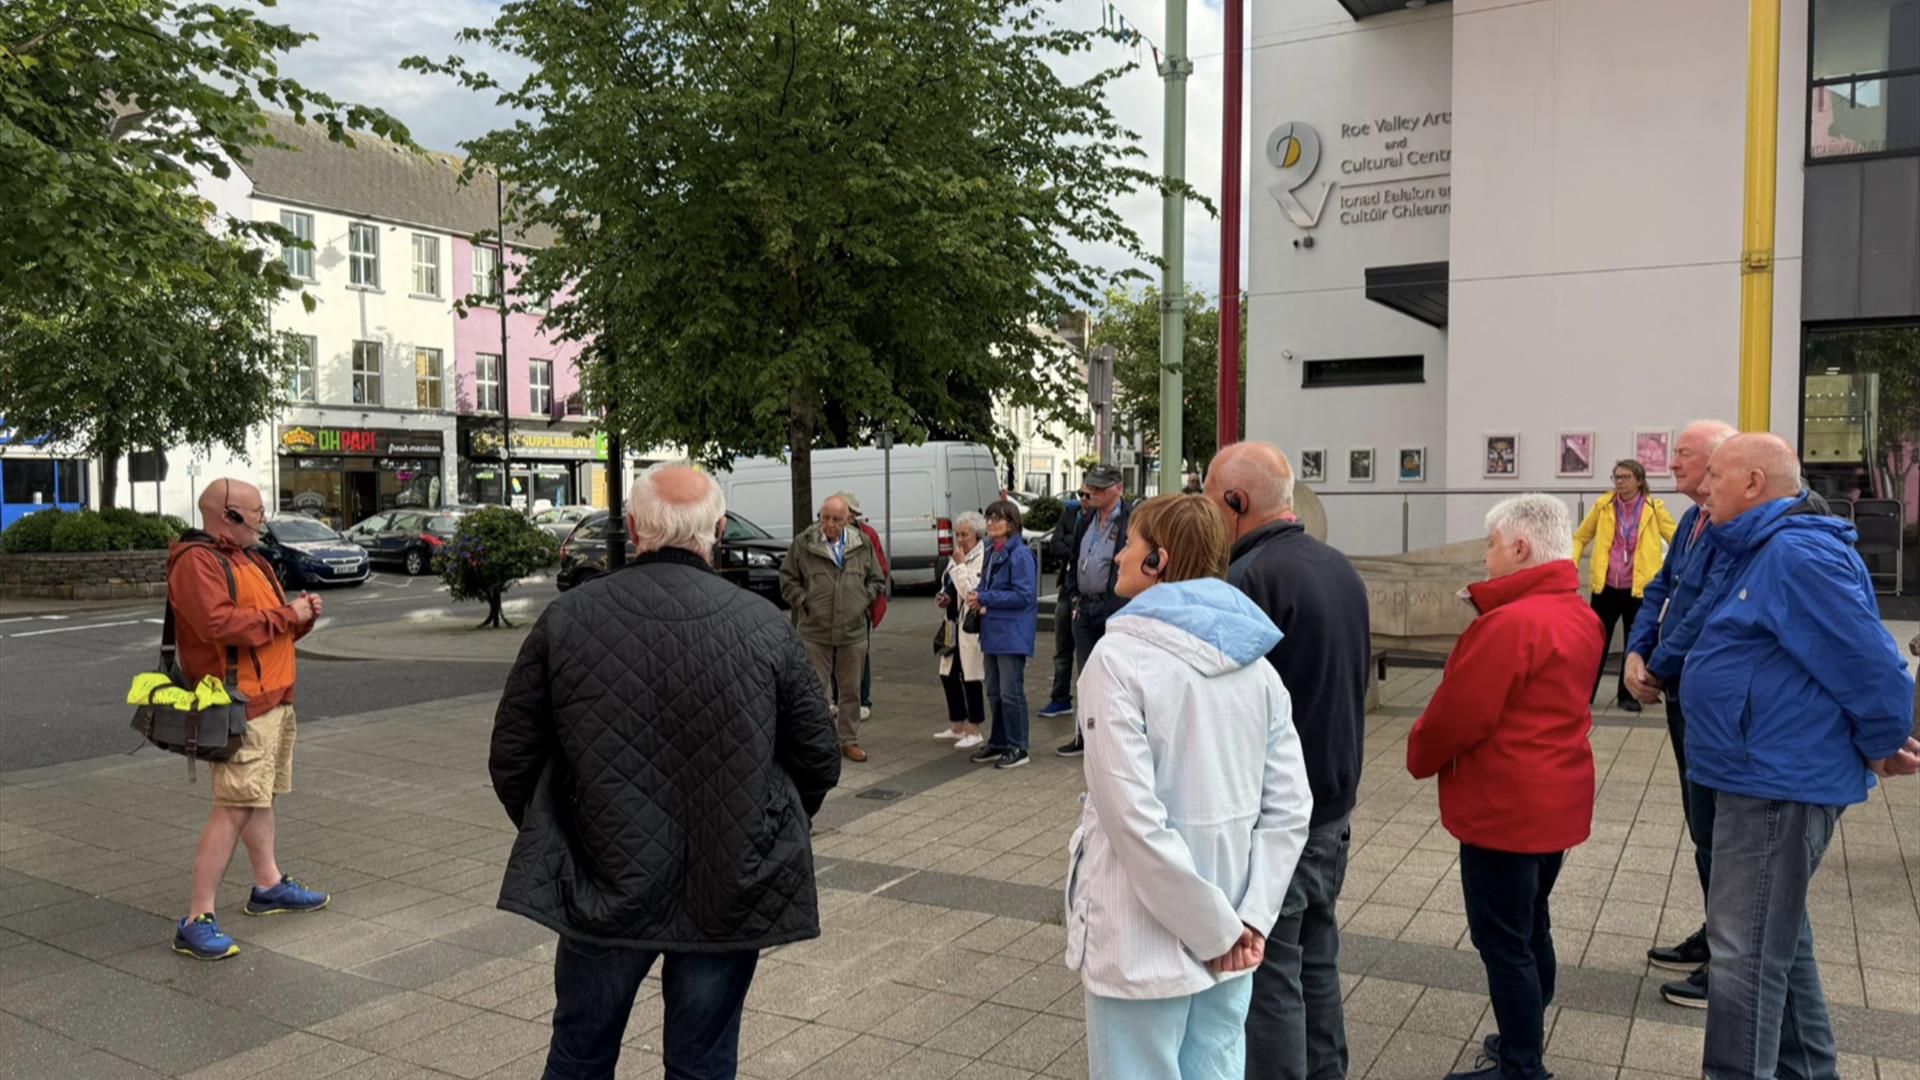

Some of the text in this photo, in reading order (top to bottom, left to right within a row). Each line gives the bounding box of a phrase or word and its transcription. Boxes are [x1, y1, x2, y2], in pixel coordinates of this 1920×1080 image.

[1341, 123, 1370, 138] Roe
[1375, 115, 1420, 133] Valley
[1385, 136, 1407, 150] and
[1341, 152, 1402, 174] Cultural
[319, 430, 340, 451] OH
